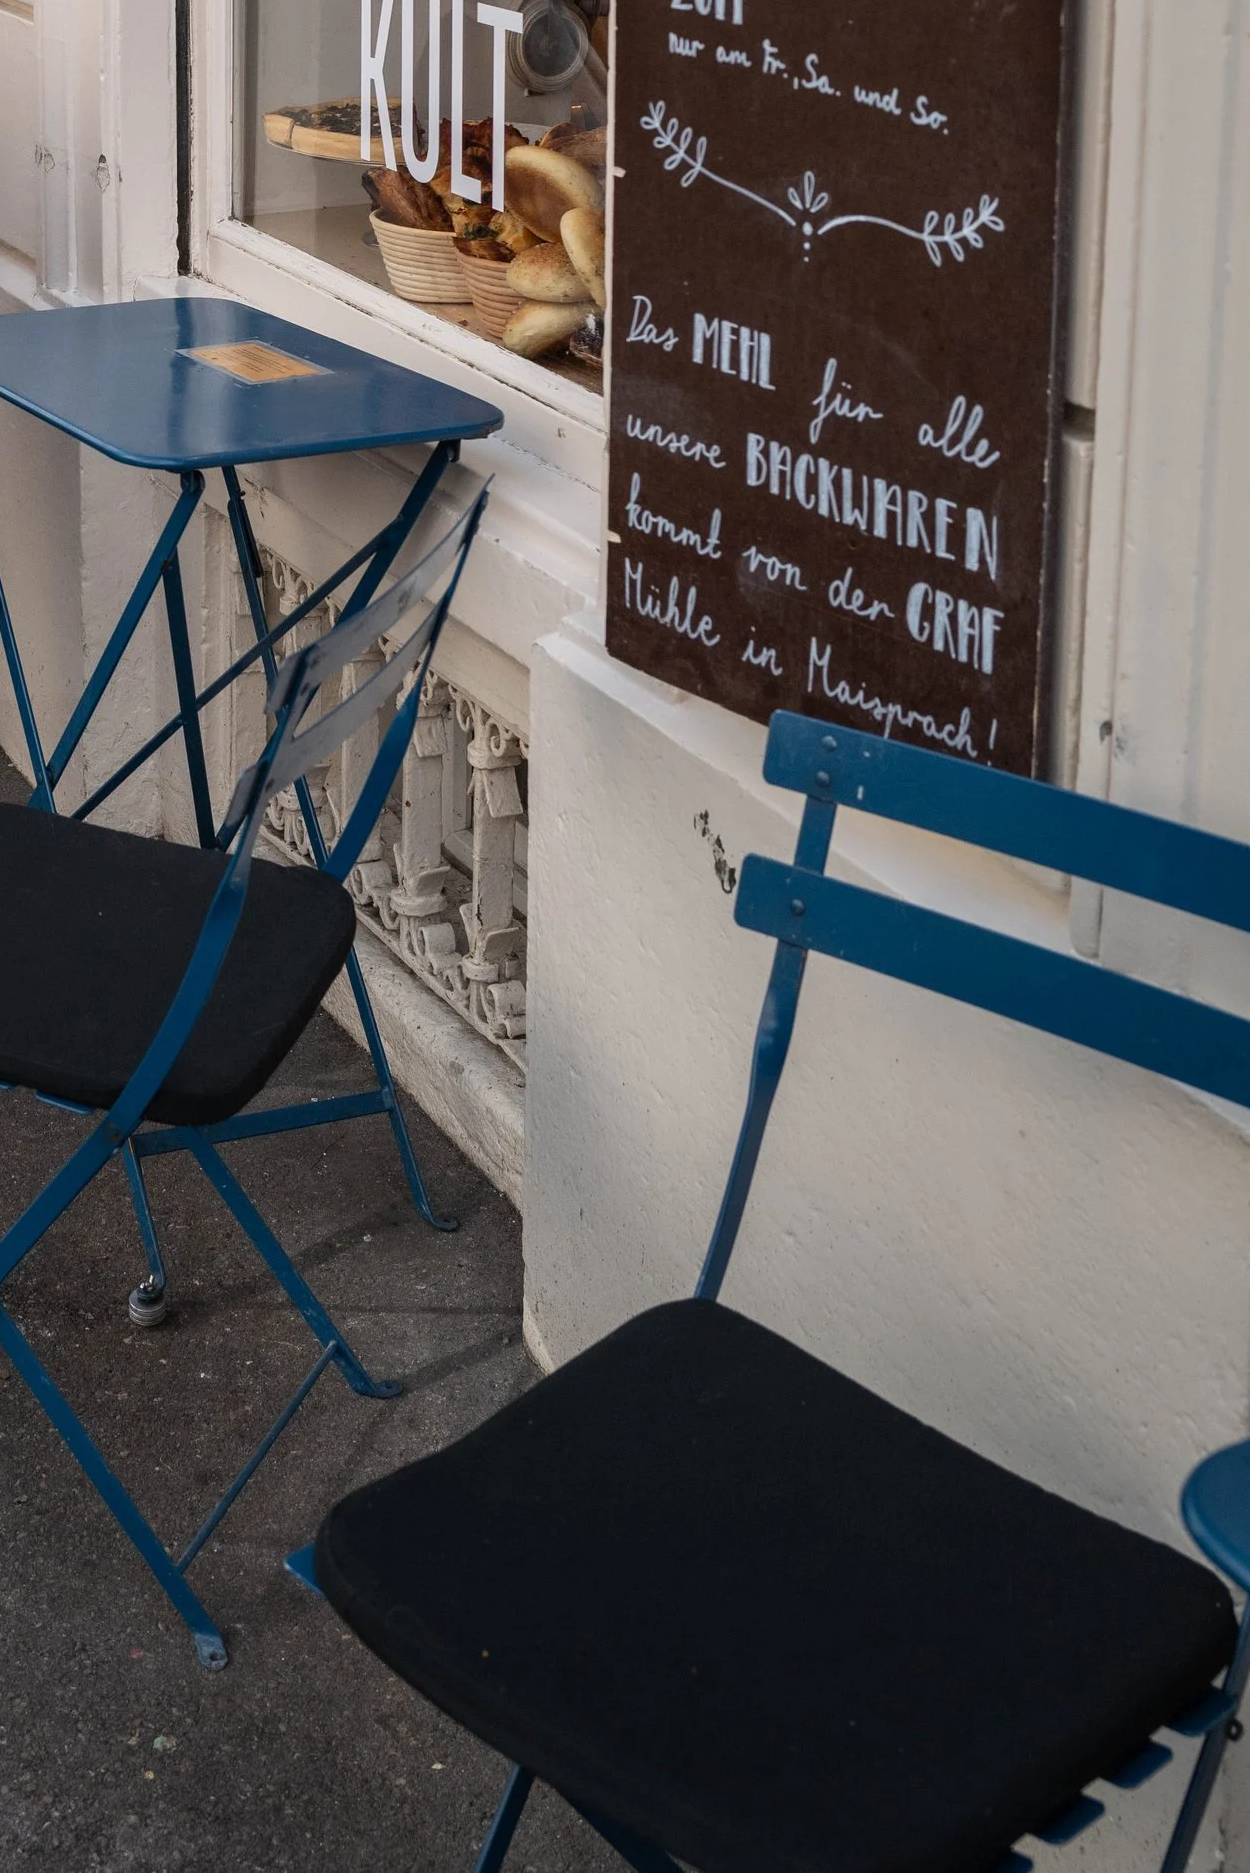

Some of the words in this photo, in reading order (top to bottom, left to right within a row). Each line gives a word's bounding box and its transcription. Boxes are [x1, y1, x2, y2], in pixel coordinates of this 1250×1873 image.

[669, 31, 705, 57] nur
[716, 45, 751, 68] am
[854, 83, 902, 116] und
[910, 96, 949, 135] So.
[626, 295, 679, 351] Das
[692, 313, 776, 391] MEHL
[809, 358, 884, 444] für
[918, 395, 1001, 469] alle
[626, 414, 727, 469] unsere
[745, 433, 998, 582] BACKWAREN
[626, 473, 722, 560] kommt
[742, 545, 807, 592] von
[828, 567, 895, 621] der
[905, 582, 1004, 675] GRAF
[623, 557, 721, 647] Mühle
[741, 627, 783, 677] in
